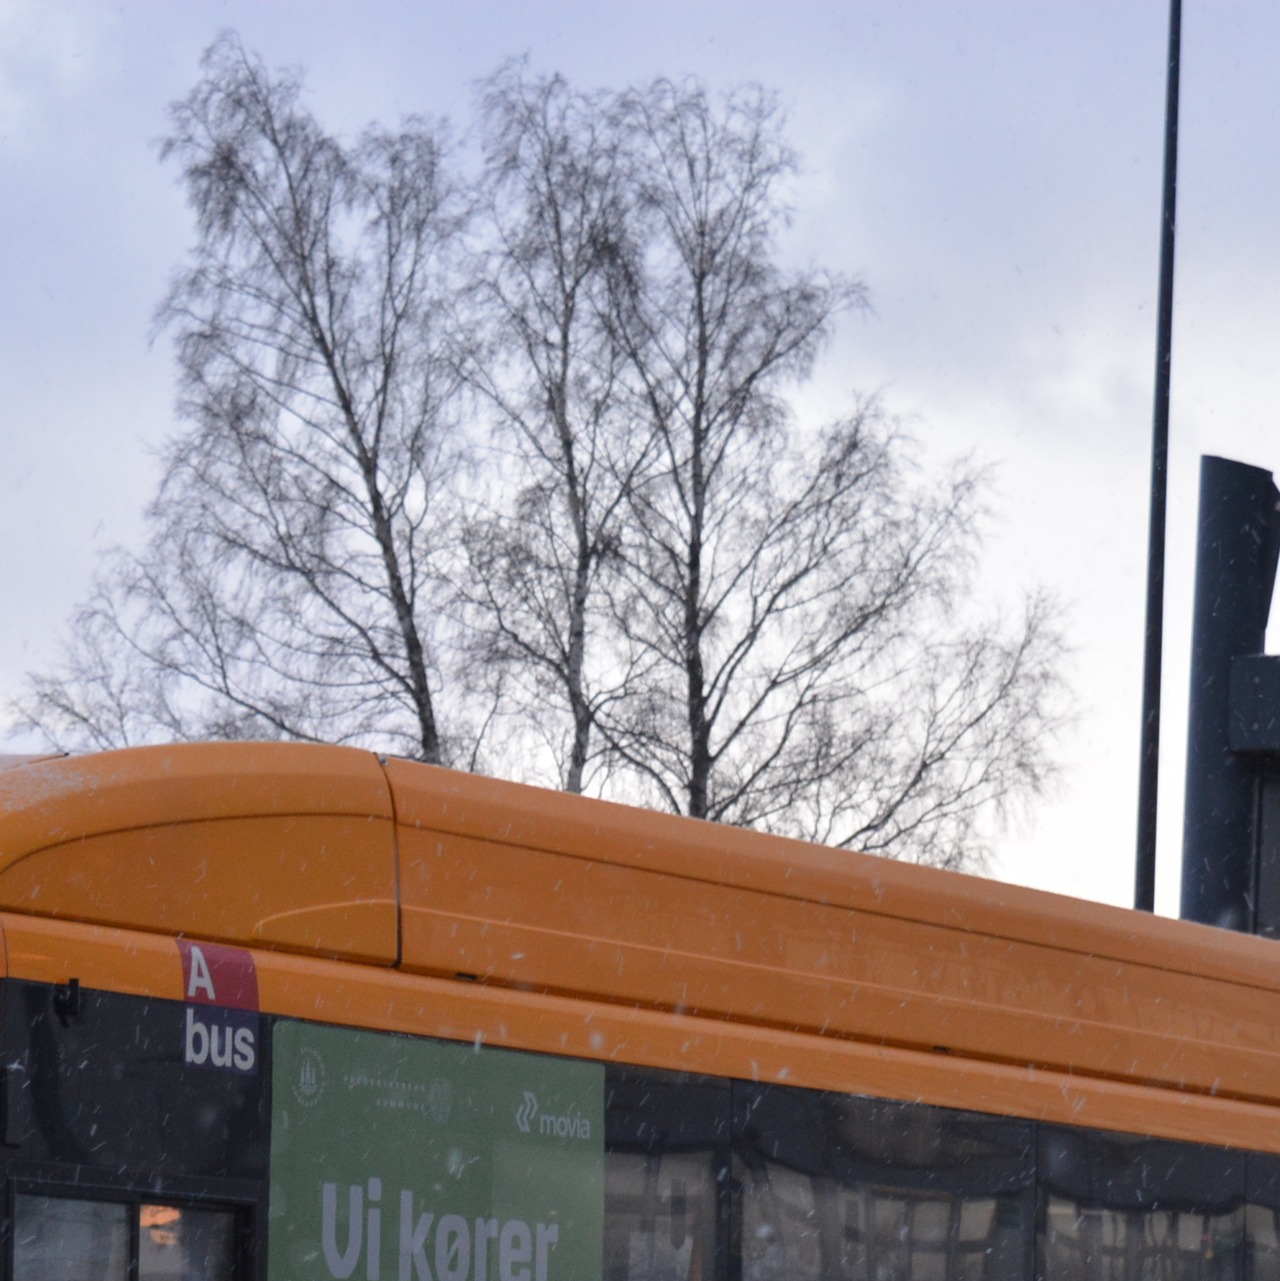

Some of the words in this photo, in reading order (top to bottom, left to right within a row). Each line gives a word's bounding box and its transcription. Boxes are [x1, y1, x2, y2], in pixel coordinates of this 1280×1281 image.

[187, 945, 216, 1000] A
[185, 1008, 255, 1071] bus
[539, 1112, 591, 1140] movia
[322, 1177, 382, 1281] Vi
